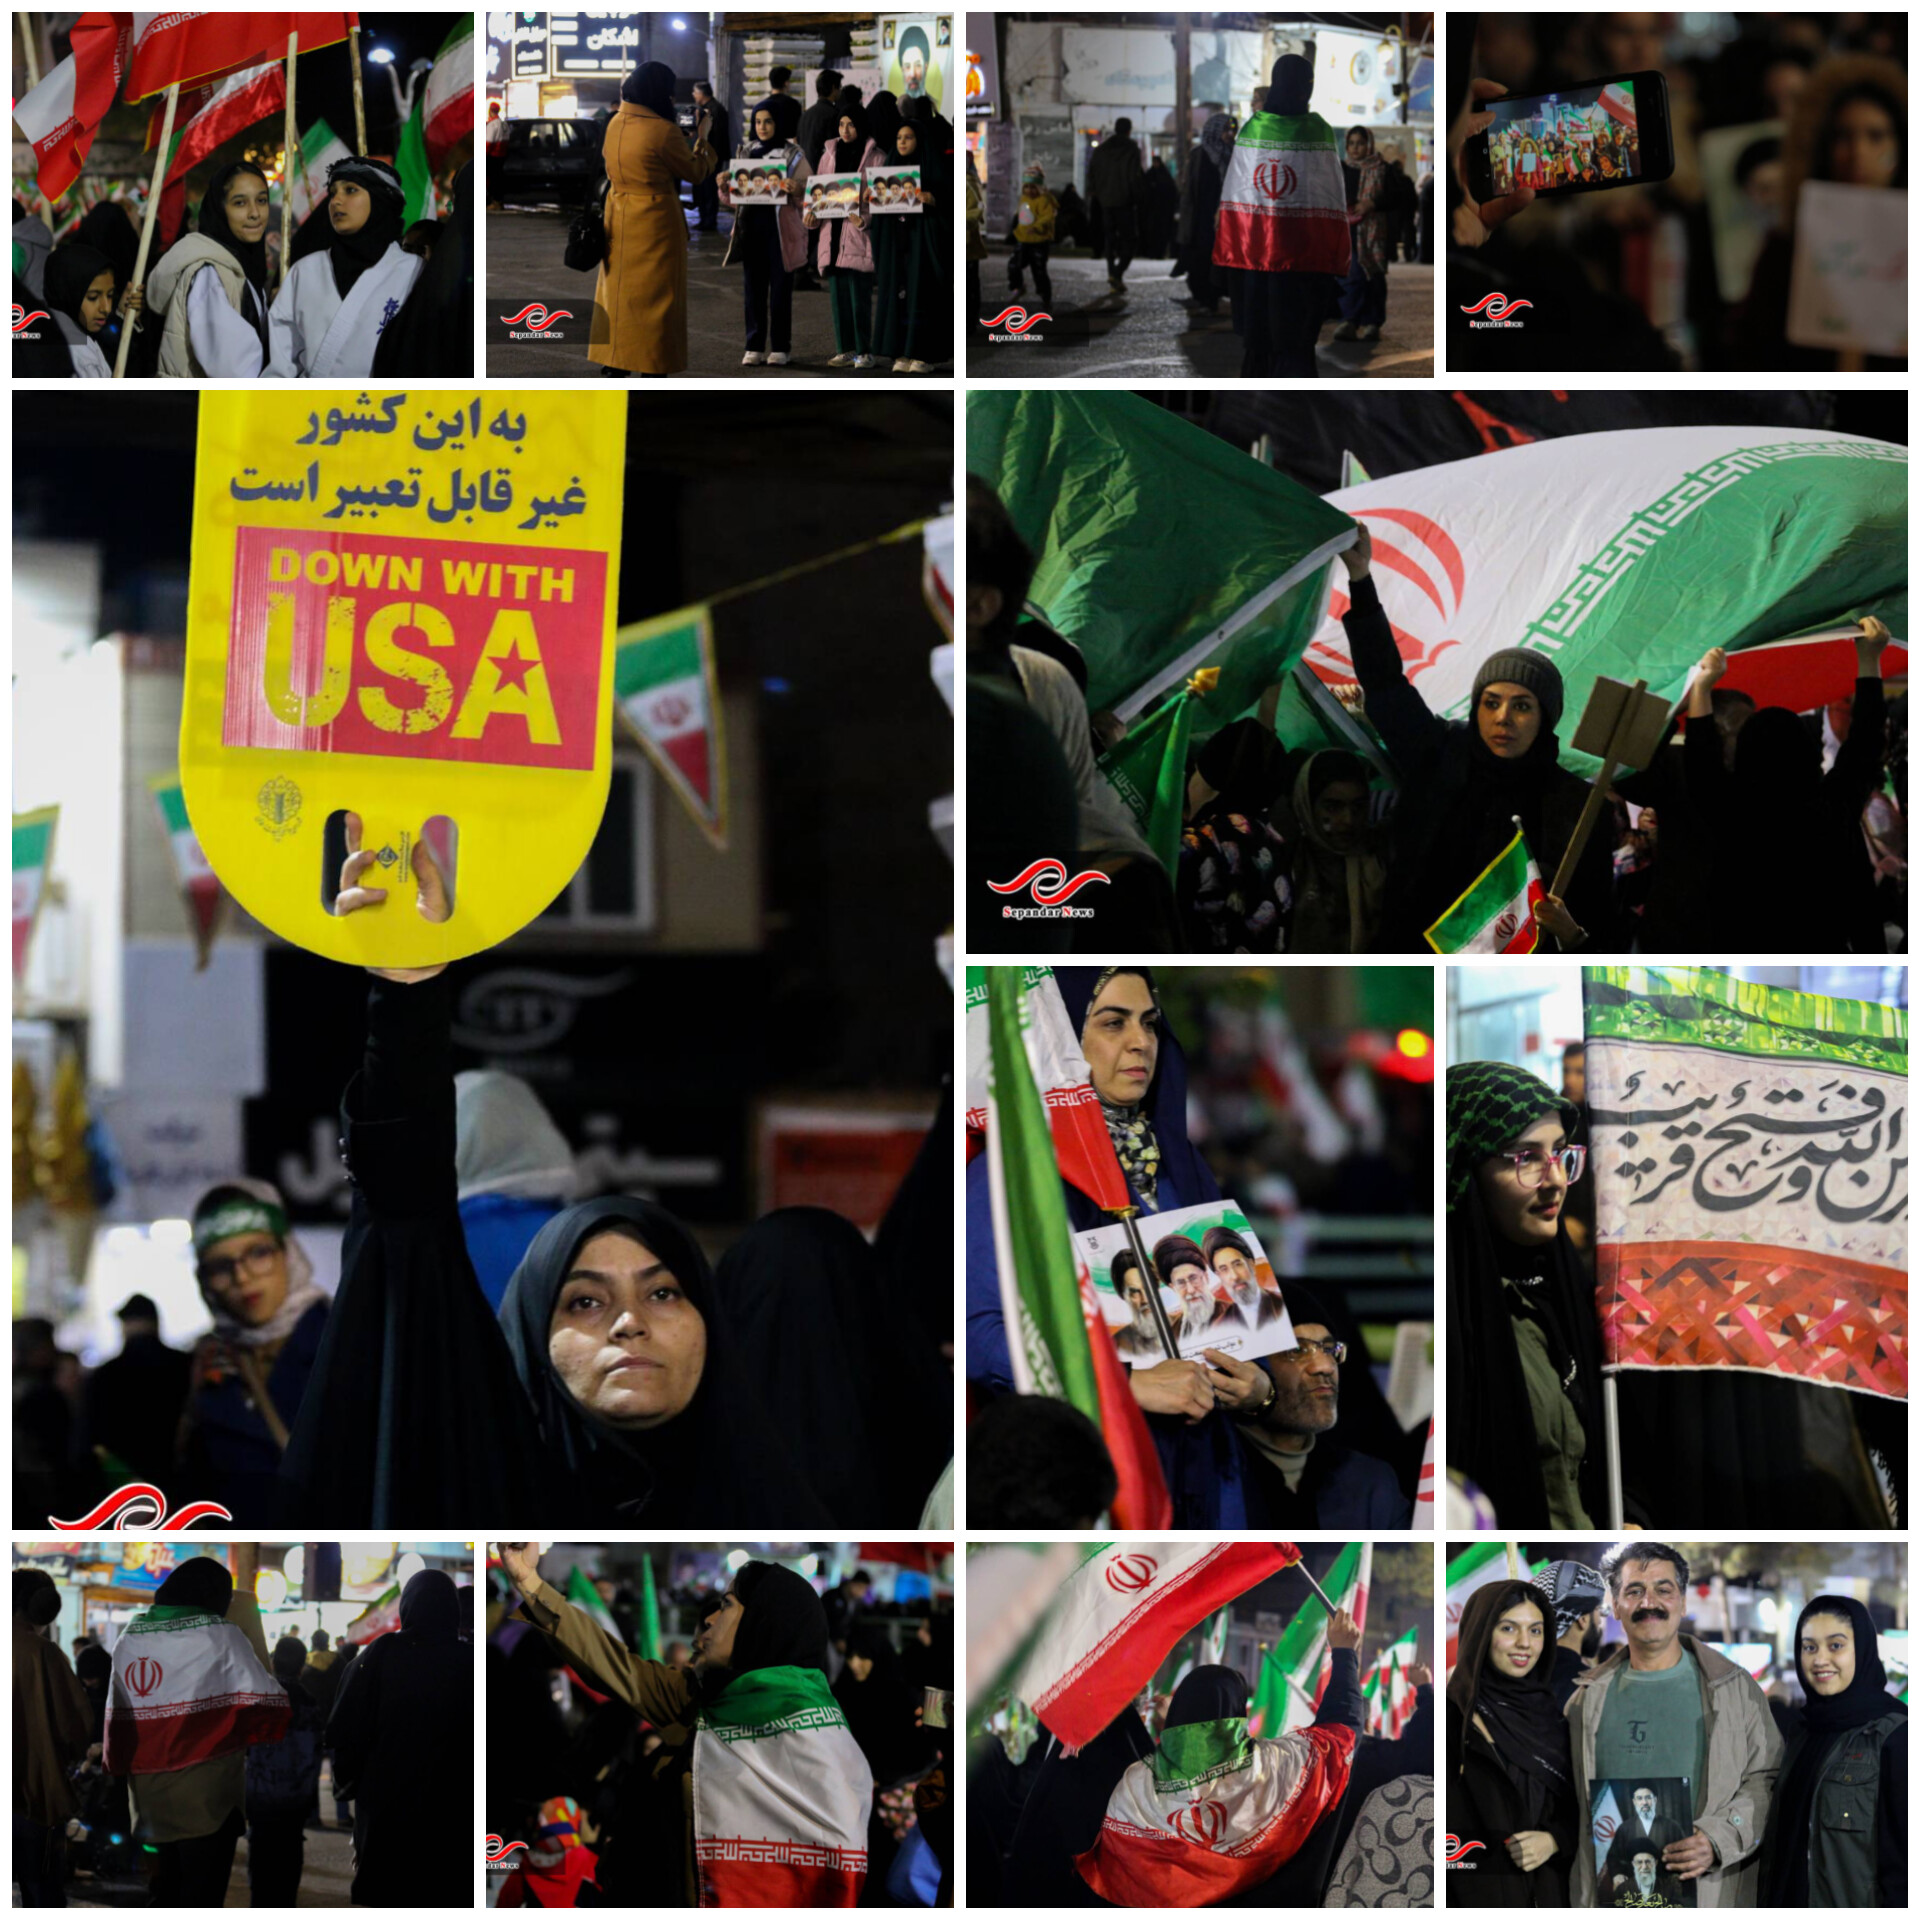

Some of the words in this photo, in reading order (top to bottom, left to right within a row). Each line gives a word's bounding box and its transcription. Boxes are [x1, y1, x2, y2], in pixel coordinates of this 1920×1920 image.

[295, 392, 408, 446] کشور
[413, 397, 482, 451] این
[488, 408, 527, 454] به
[230, 460, 320, 503] است
[322, 467, 423, 519] تعبیر
[427, 467, 514, 524] قابل
[517, 475, 588, 530] غیر
[268, 547, 424, 592] DOWN
[441, 559, 576, 604] WITH
[262, 591, 564, 747] USA
